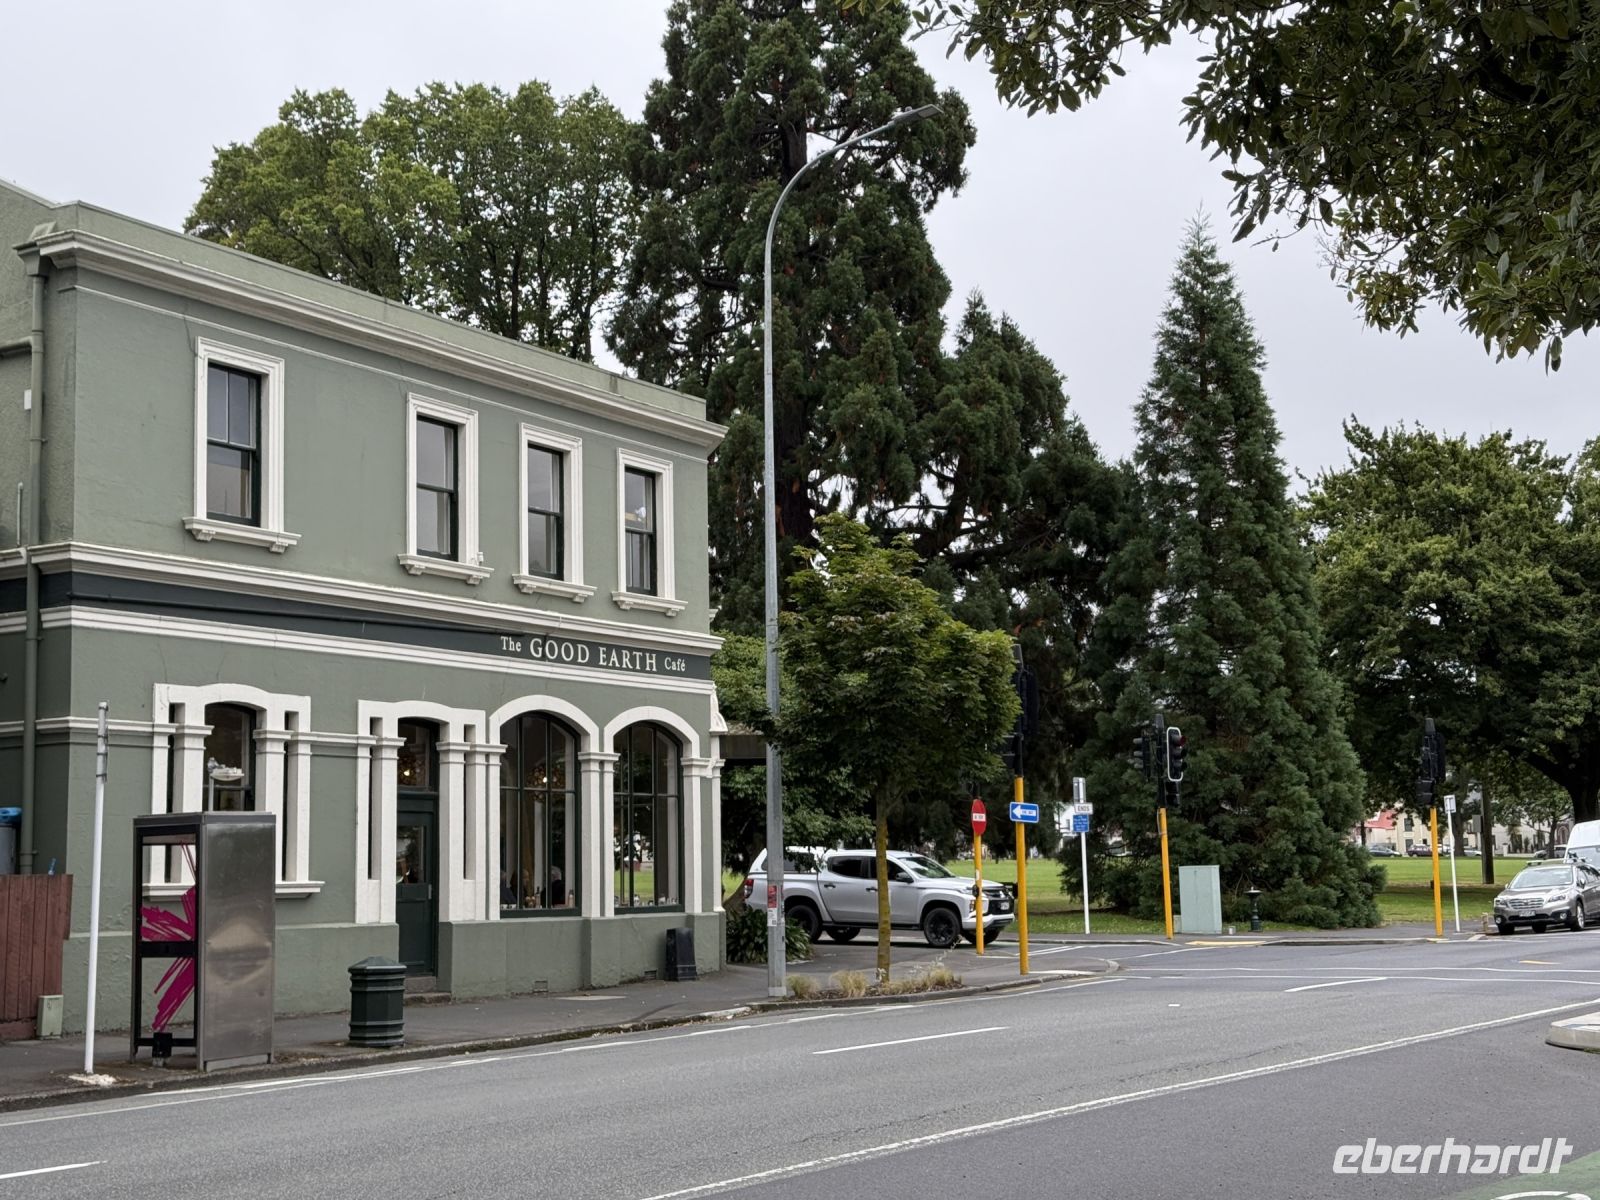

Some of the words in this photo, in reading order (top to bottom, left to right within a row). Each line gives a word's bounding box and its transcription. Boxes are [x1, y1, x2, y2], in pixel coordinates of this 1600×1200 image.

[500, 636, 522, 652] The
[529, 638, 590, 664] GOOD
[598, 646, 657, 672] EARTH
[664, 657, 686, 672] Café
